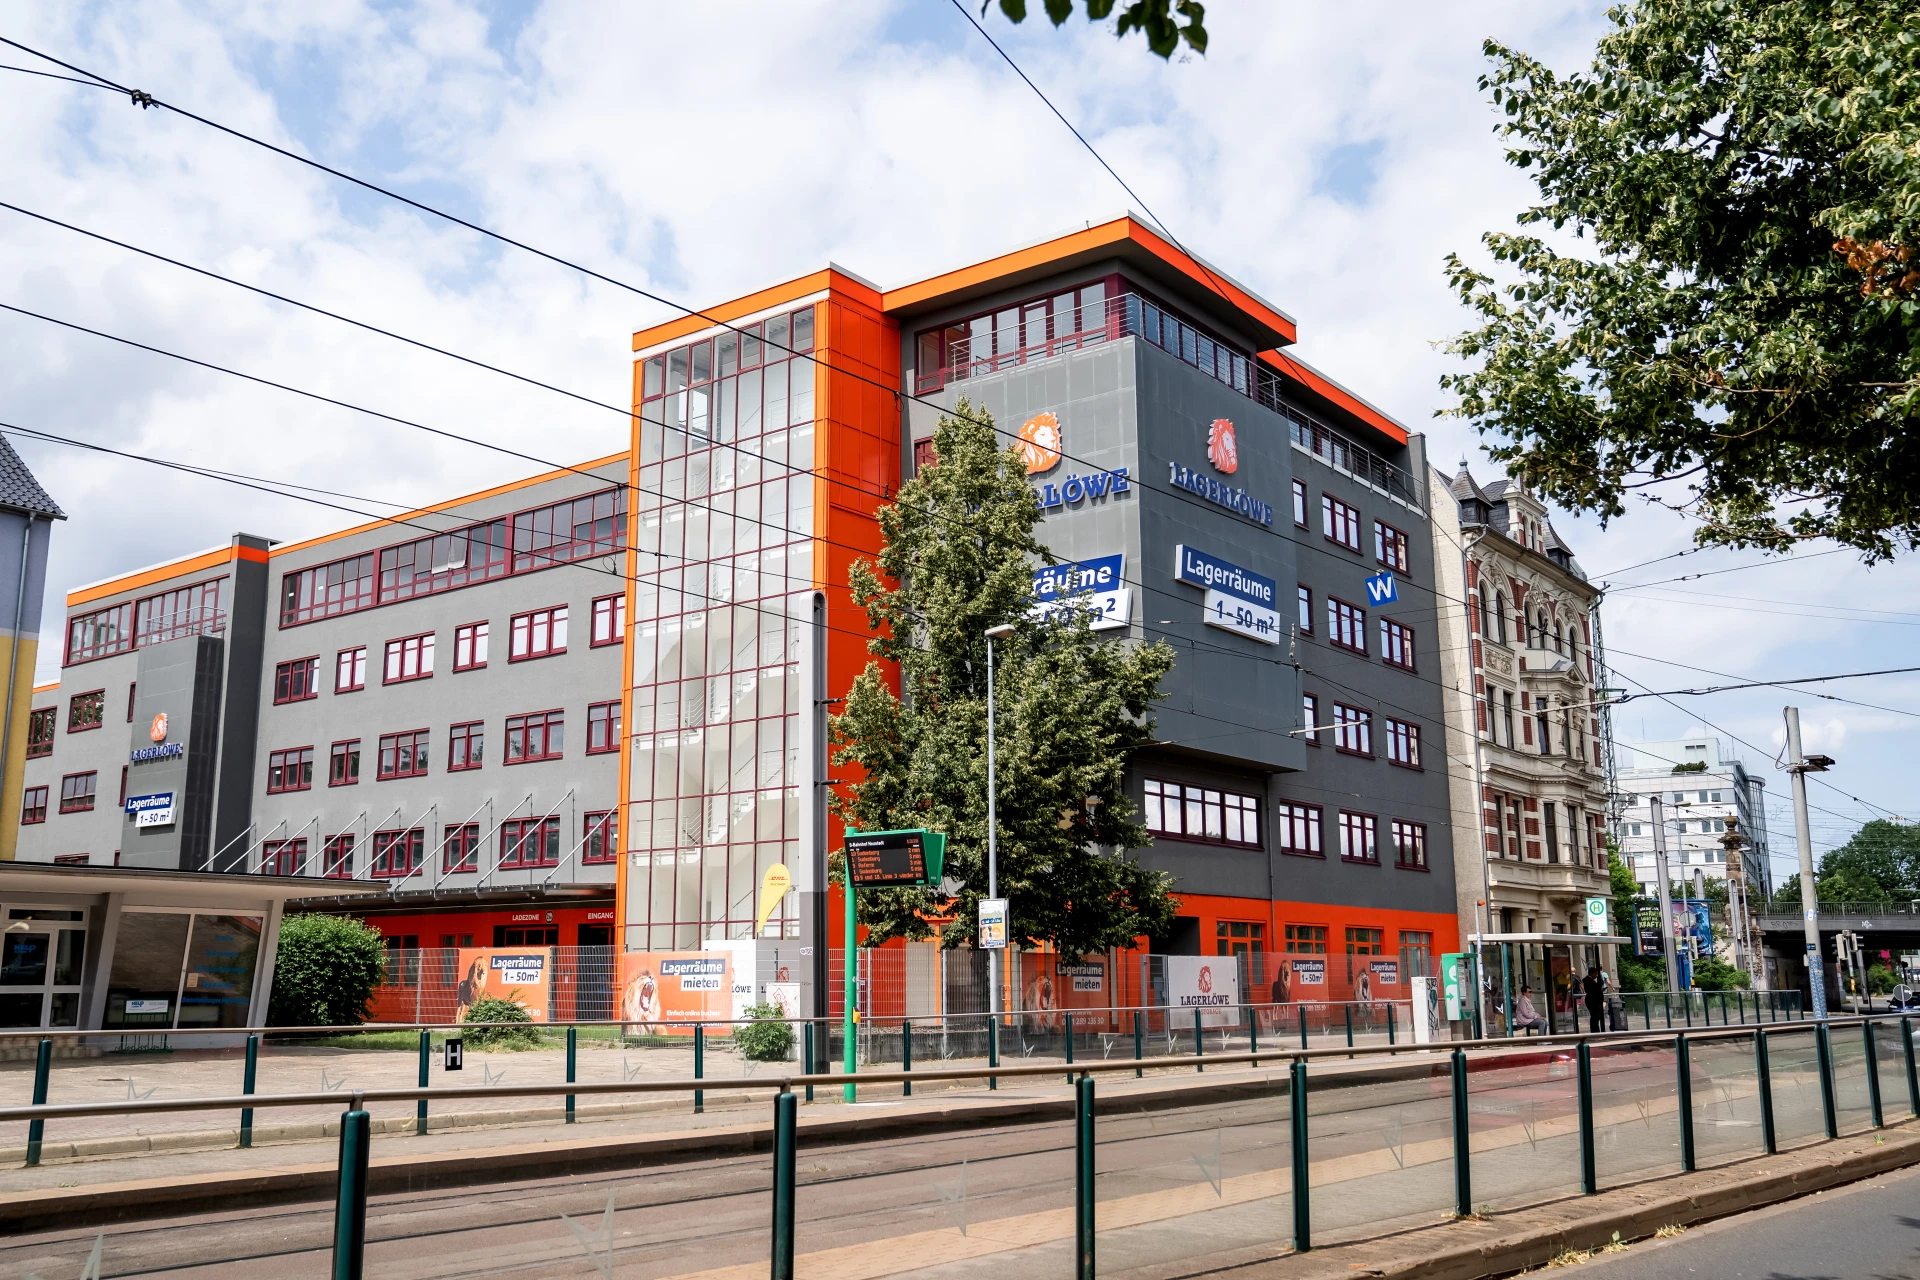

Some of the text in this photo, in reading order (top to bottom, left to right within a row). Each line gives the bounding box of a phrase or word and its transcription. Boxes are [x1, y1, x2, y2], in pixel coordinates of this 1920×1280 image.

[1170, 461, 1273, 526] LAGERLÖWE
[1187, 552, 1271, 601] Lagerräume
[1367, 576, 1392, 601] W
[131, 743, 183, 760] LAGERLÖWE
[127, 796, 170, 811] Lagerräume
[588, 912, 614, 920] EINGANG
[492, 957, 542, 969] Lagerräume
[663, 961, 723, 975] Lagerräume
[1293, 962, 1324, 972] Lagerräume
[1370, 963, 1397, 973] Lagerräume
[683, 976, 719, 988] mieten
[1075, 979, 1100, 989] mieten
[1381, 974, 1395, 982] mieten
[1181, 993, 1229, 1005] LAGERLÖWE
[447, 1044, 461, 1066] H
